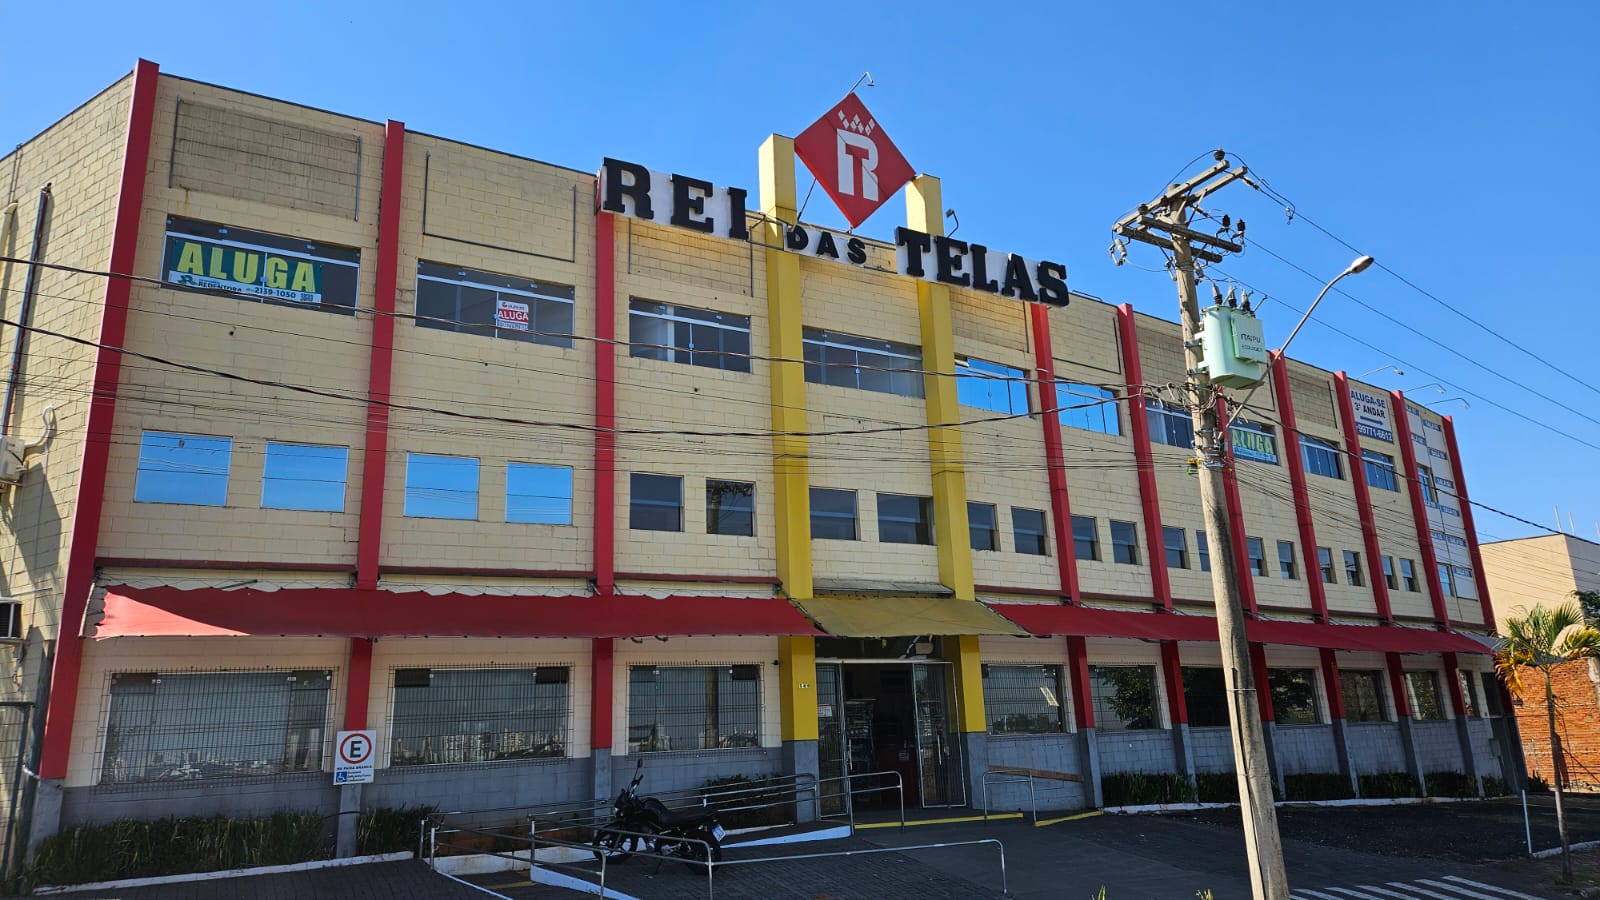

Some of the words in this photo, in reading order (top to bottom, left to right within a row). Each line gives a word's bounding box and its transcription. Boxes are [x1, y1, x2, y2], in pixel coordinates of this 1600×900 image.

[603, 157, 749, 241] REI
[787, 226, 867, 265] DAS
[896, 226, 1070, 308] TELAS
[177, 241, 316, 293] ALUGA
[498, 310, 529, 321] ALUGA
[1351, 390, 1386, 409] ALUGA-SE
[1363, 404, 1386, 419] ANDAR
[1231, 428, 1274, 455] ALUGA
[350, 740, 362, 758] E
